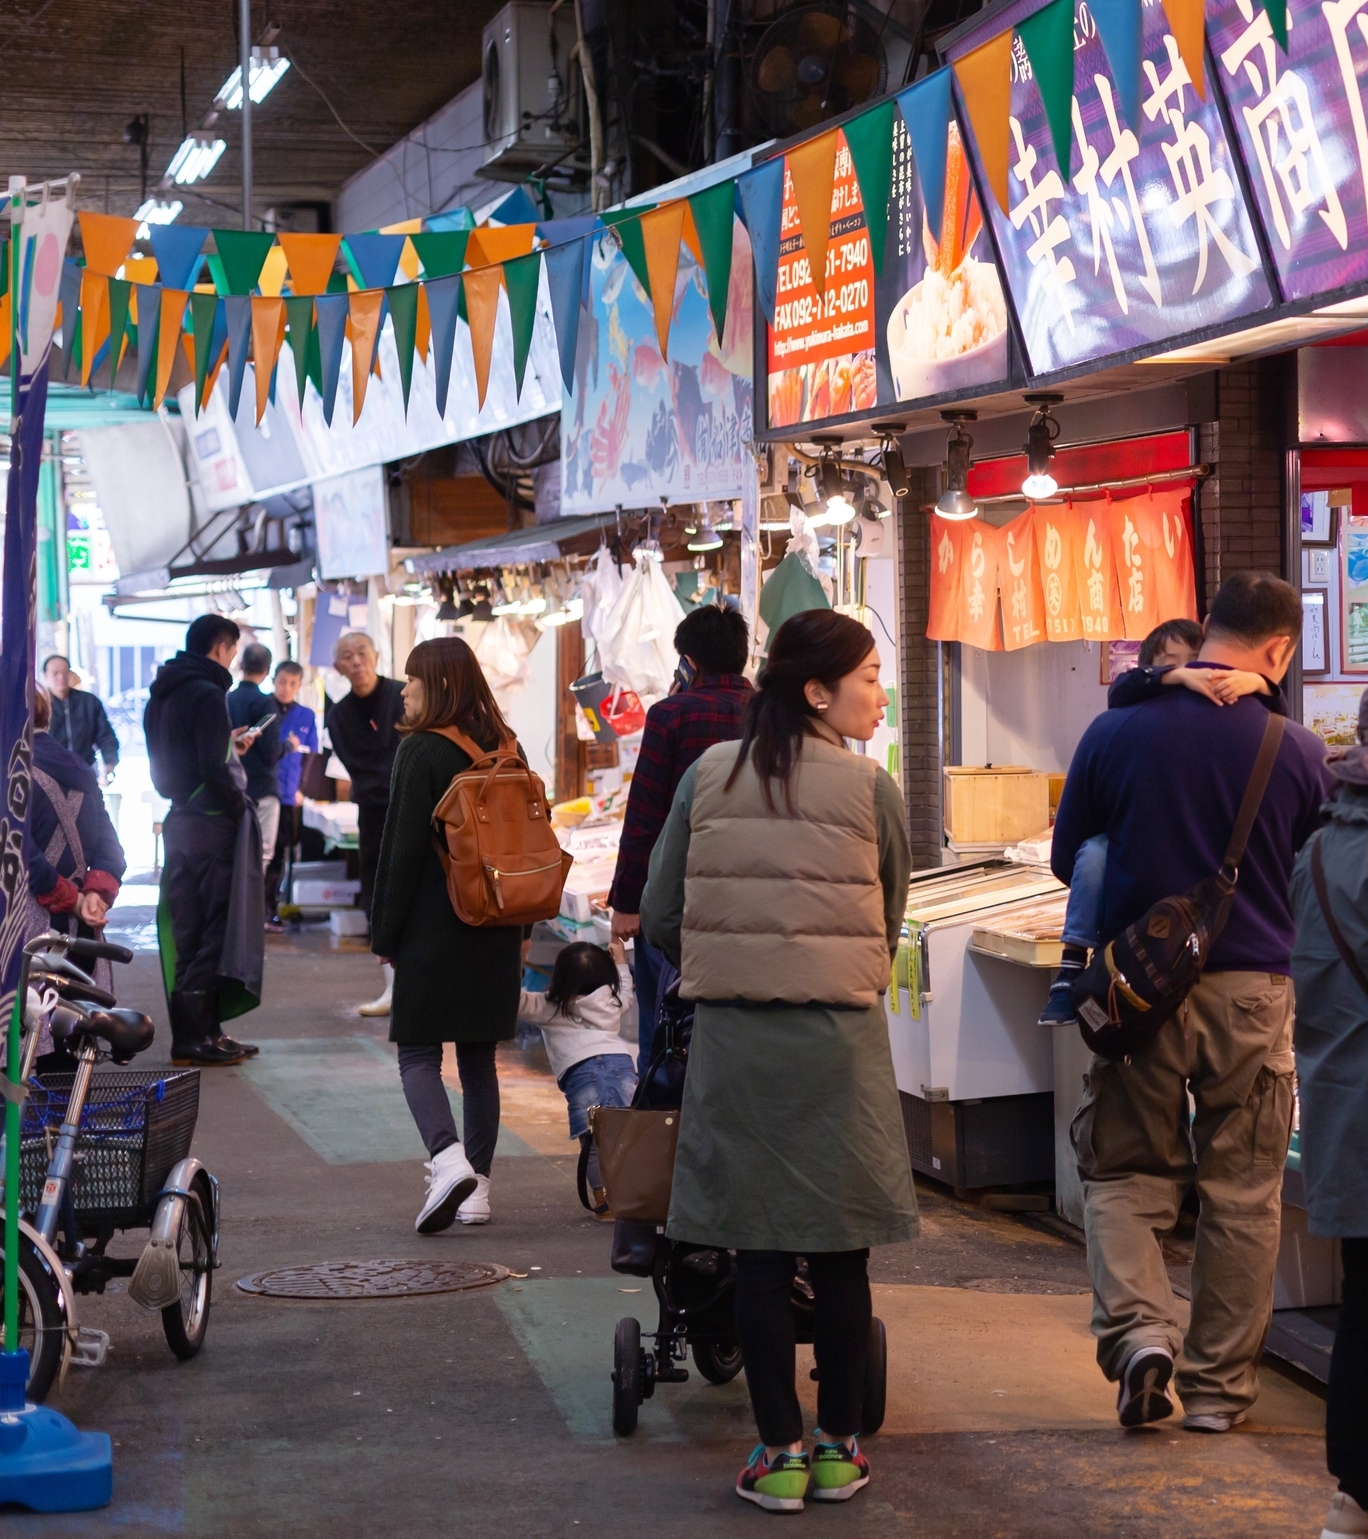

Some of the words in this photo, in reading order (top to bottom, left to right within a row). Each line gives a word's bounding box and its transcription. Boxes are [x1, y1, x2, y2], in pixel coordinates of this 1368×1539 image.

[937, 511, 1183, 578] からしめんたい
[1013, 621, 1040, 643] TEL
